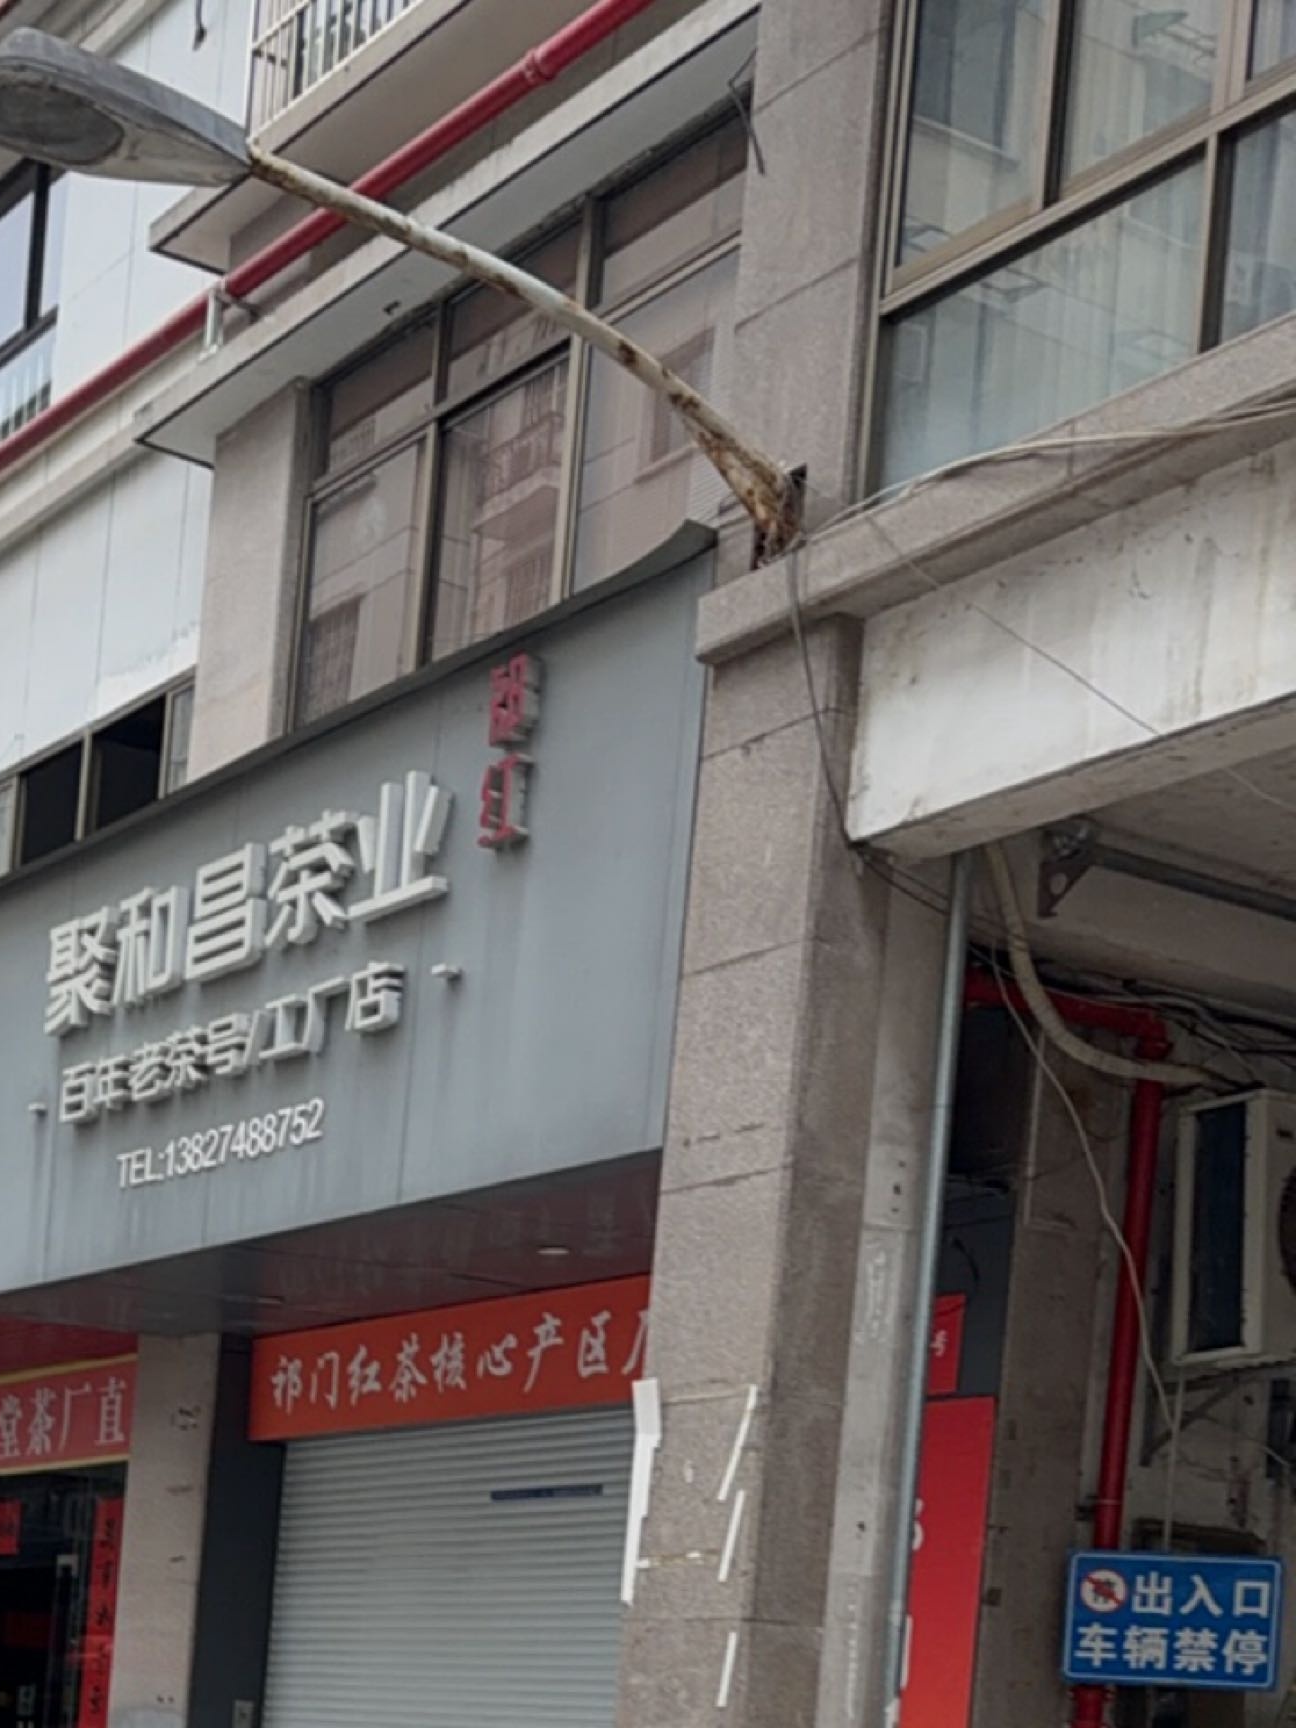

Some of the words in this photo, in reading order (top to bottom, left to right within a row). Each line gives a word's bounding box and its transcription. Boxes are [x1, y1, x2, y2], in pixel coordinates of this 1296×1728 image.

[44, 771, 452, 1036] 聚和昌茶业
[59, 961, 405, 1123] 百年老茶号/工厂店
[116, 1097, 326, 1188] TEL:13827488752
[1131, 1571, 1271, 1620] 出入口
[1074, 1623, 1269, 1677] 车辆禁停
